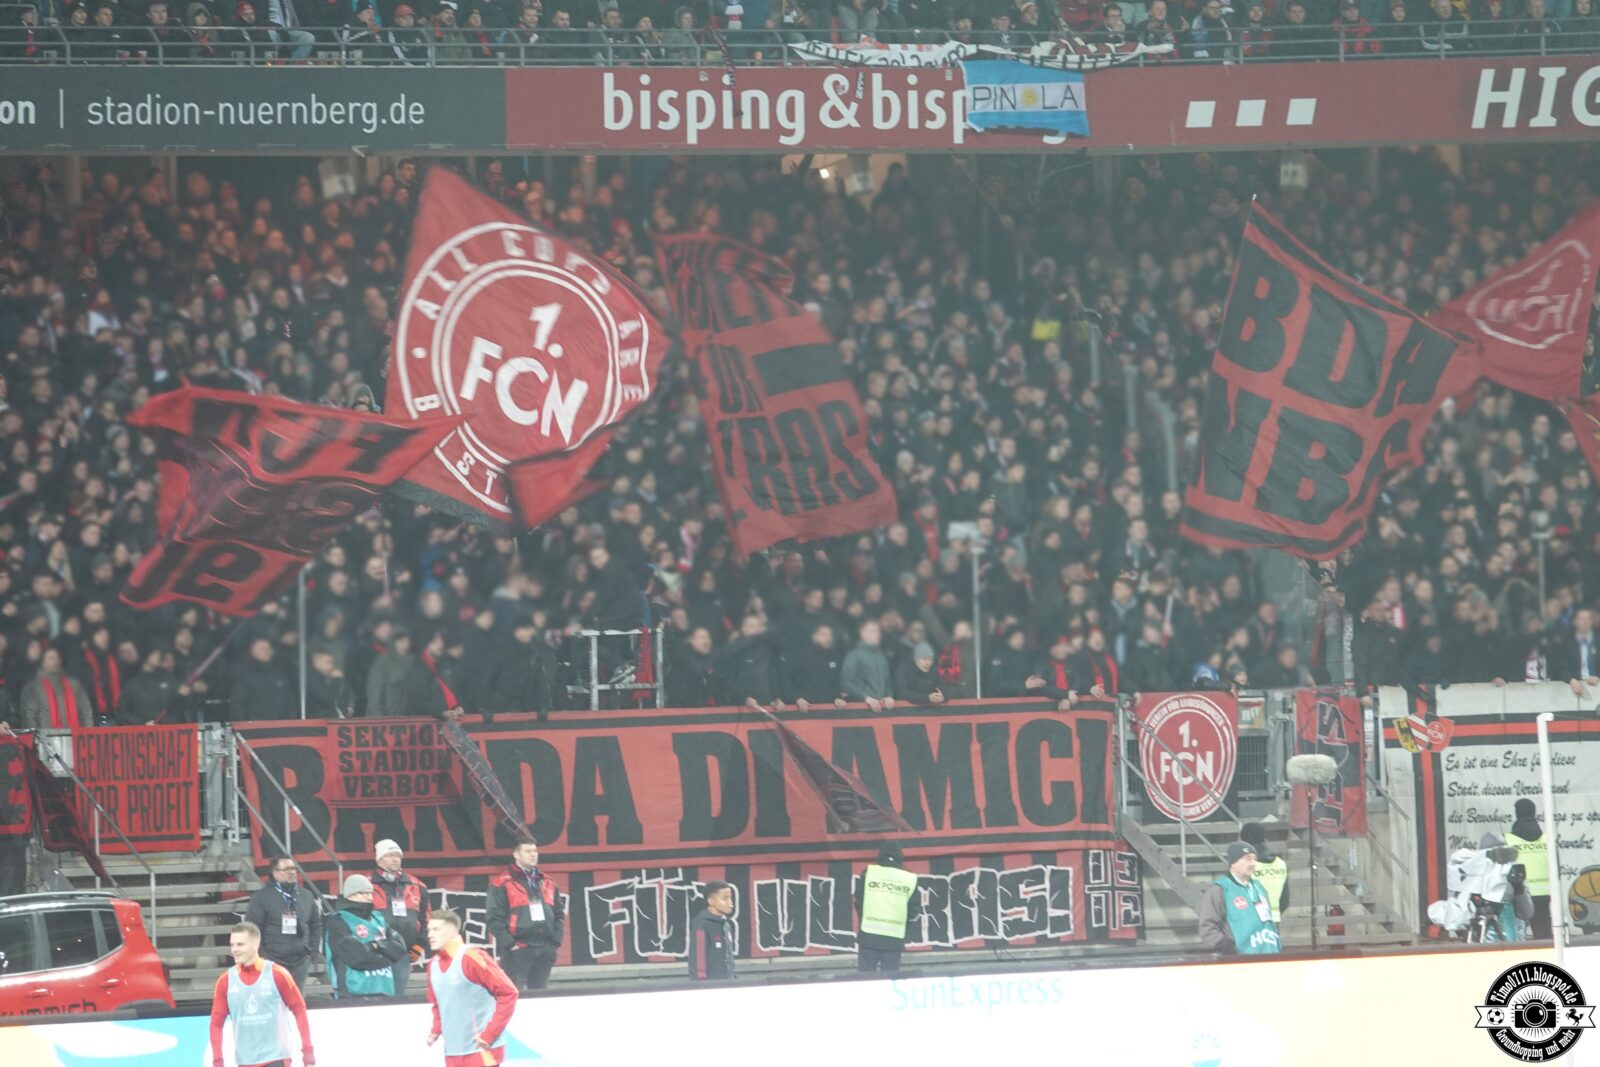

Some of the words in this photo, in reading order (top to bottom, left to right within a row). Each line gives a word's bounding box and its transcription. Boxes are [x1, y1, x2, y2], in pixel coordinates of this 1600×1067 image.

[87, 93, 426, 133] stadion-nuernberg.de
[603, 72, 805, 145] bisping
[819, 73, 862, 129] &
[528, 302, 564, 359] 1.
[460, 337, 590, 445] FCN
[76, 729, 195, 783] GEMEINSCHAFT
[1178, 719, 1199, 748] 1.
[338, 748, 453, 774] STADION
[343, 774, 452, 799] VERBOT
[672, 728, 792, 842] DI
[826, 717, 1110, 835] AMICI
[1159, 750, 1215, 786] FCN
[128, 781, 193, 833] PROFIT
[753, 865, 1075, 952] ULRAS!
[891, 975, 1064, 1016] SunExpress
